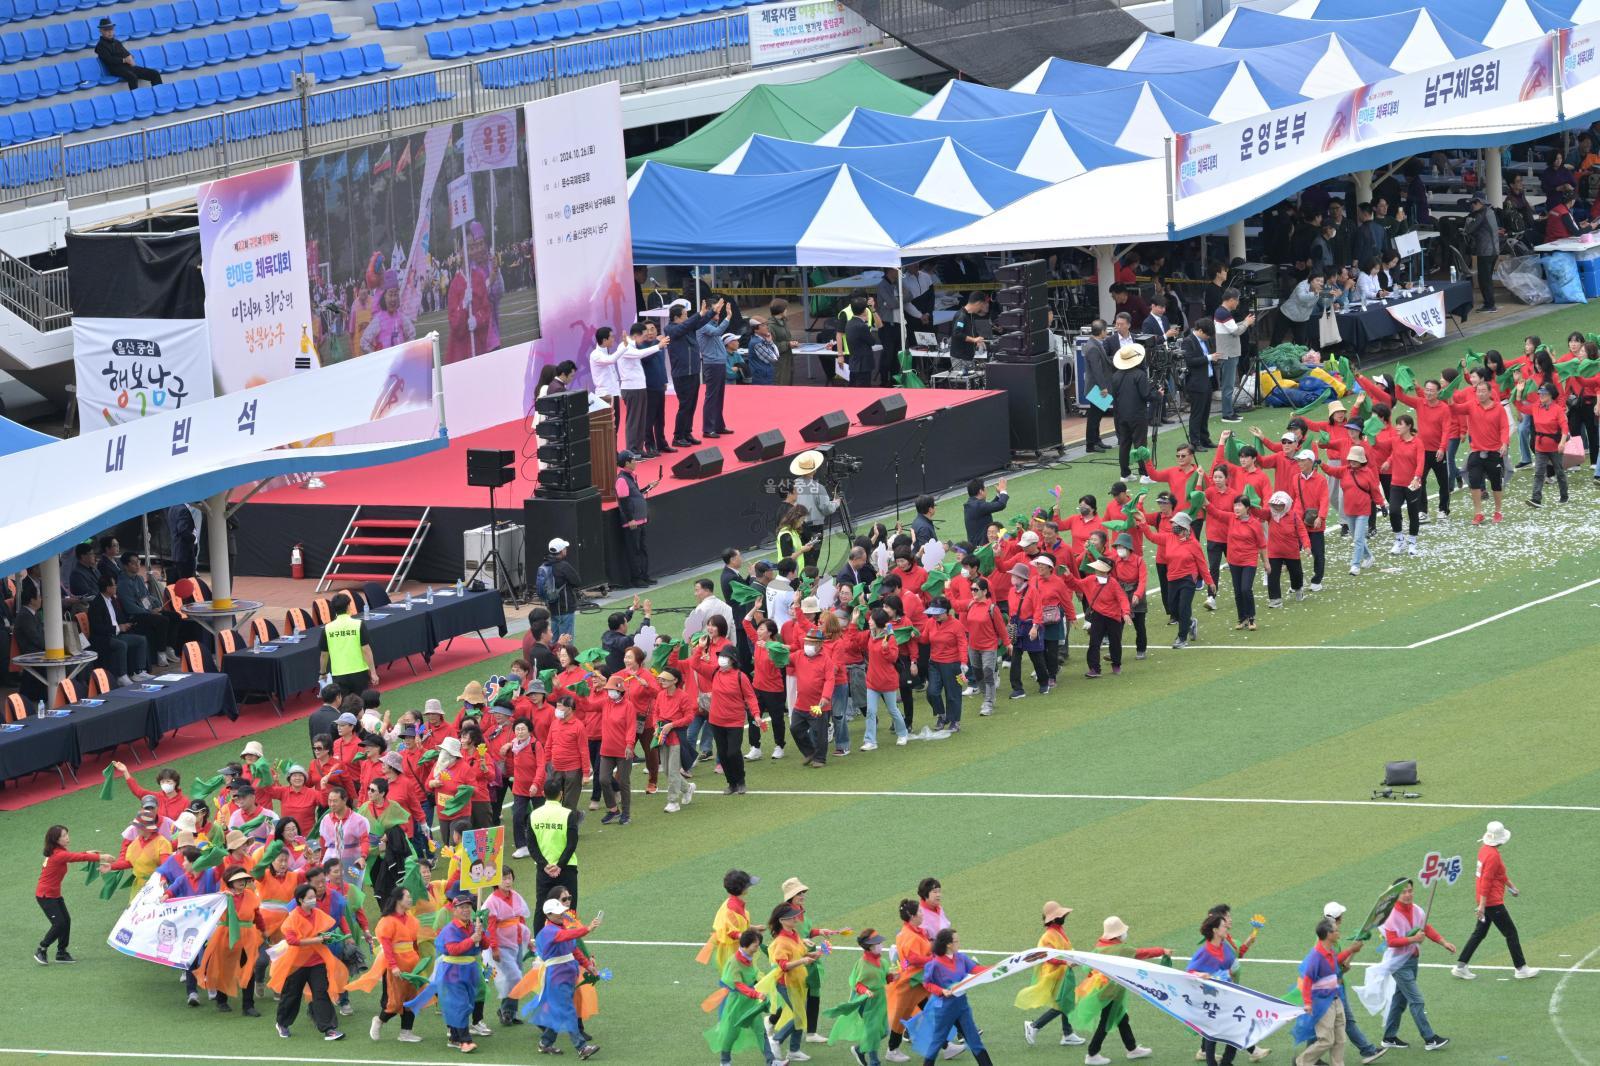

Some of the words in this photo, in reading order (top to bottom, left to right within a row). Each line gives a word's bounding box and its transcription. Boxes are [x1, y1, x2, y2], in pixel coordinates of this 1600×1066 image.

[761, 6, 797, 23] 체육시설
[1424, 60, 1500, 108] 남구체육회
[1240, 112, 1307, 162] 운영본부
[1197, 153, 1218, 175] 체육대회
[226, 260, 254, 288] 한마음
[256, 250, 292, 279] 체육대회
[232, 297, 262, 323] 미래와
[265, 290, 294, 316] 희망의
[101, 360, 189, 417] 행복남구
[1420, 854, 1461, 885] 무거동
